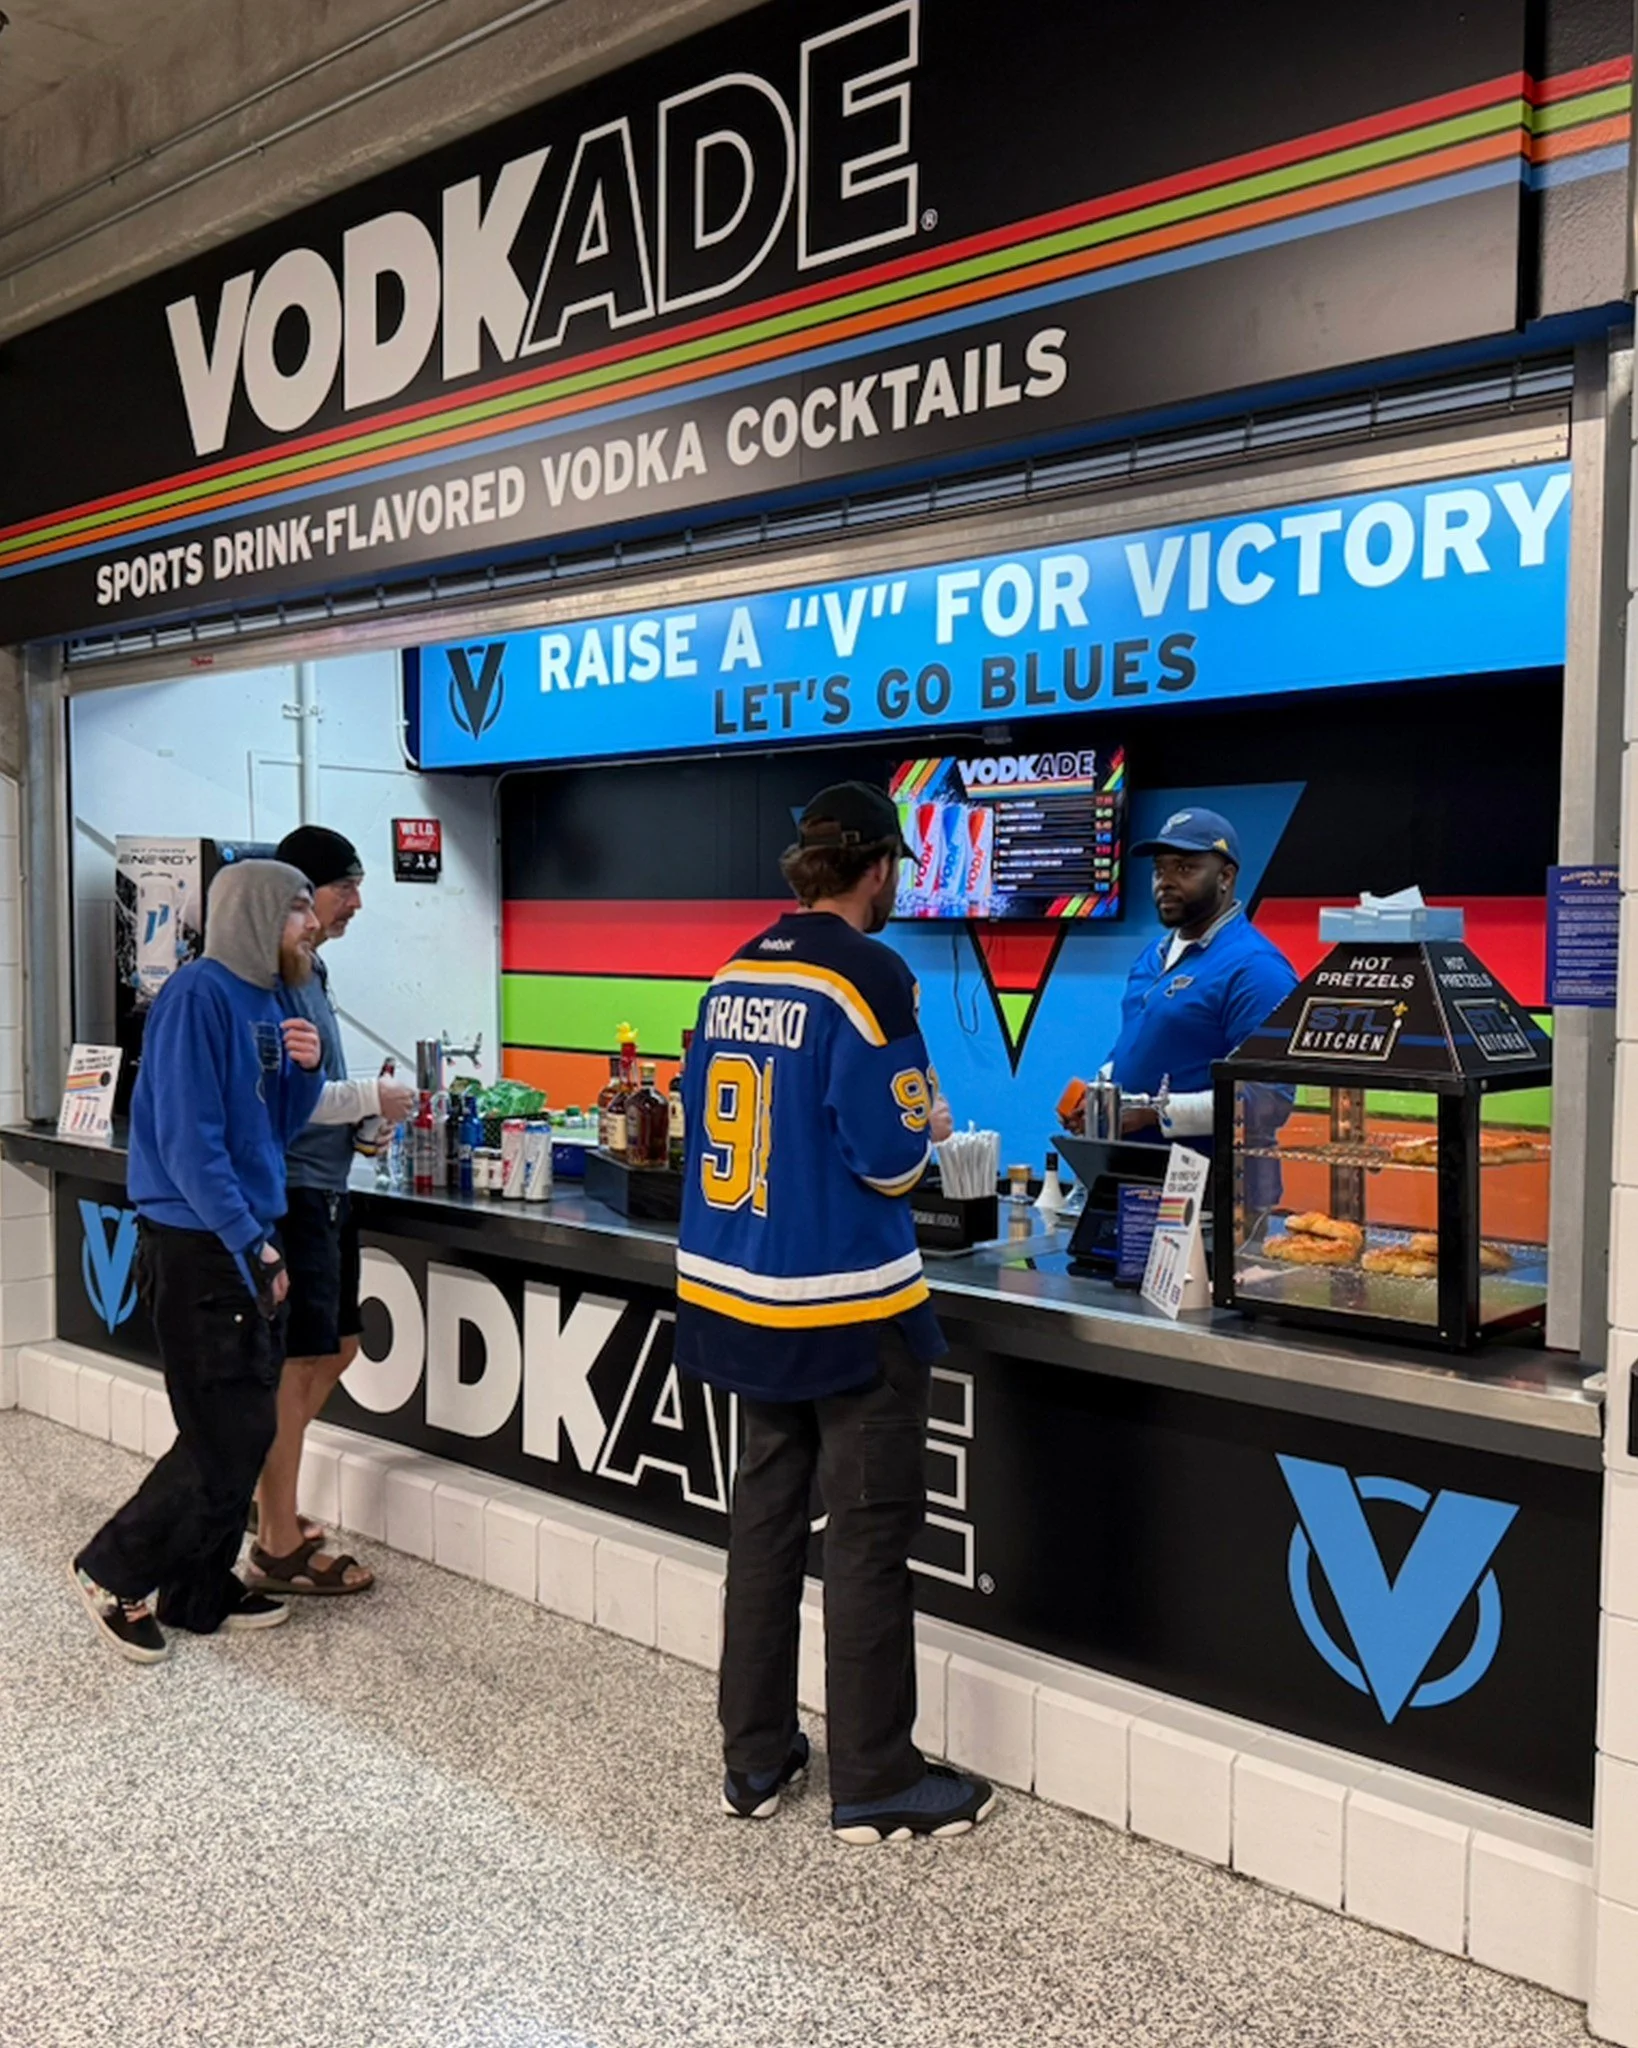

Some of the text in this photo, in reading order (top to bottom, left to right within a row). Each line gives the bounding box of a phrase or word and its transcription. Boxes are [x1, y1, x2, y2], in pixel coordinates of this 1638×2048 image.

[165, 0, 920, 457] VODKADE
[96, 327, 1068, 606] SPORTS DRINK-FLAVORED VODKA COCKTAILS
[539, 613, 698, 693] RAISE
[719, 605, 763, 672] A
[936, 552, 1091, 645] FOR
[1125, 472, 1572, 619] VICTORY
[713, 632, 1198, 735] LET'S GO BLUES
[957, 750, 1096, 786] VODKADE
[118, 854, 198, 865] ENERGY
[1351, 956, 1393, 970] HOT
[1316, 973, 1415, 989] PRETZELS
[1439, 973, 1493, 988] PRETZELS
[1310, 1006, 1388, 1032] STL
[1300, 1031, 1386, 1051] KITCHEN
